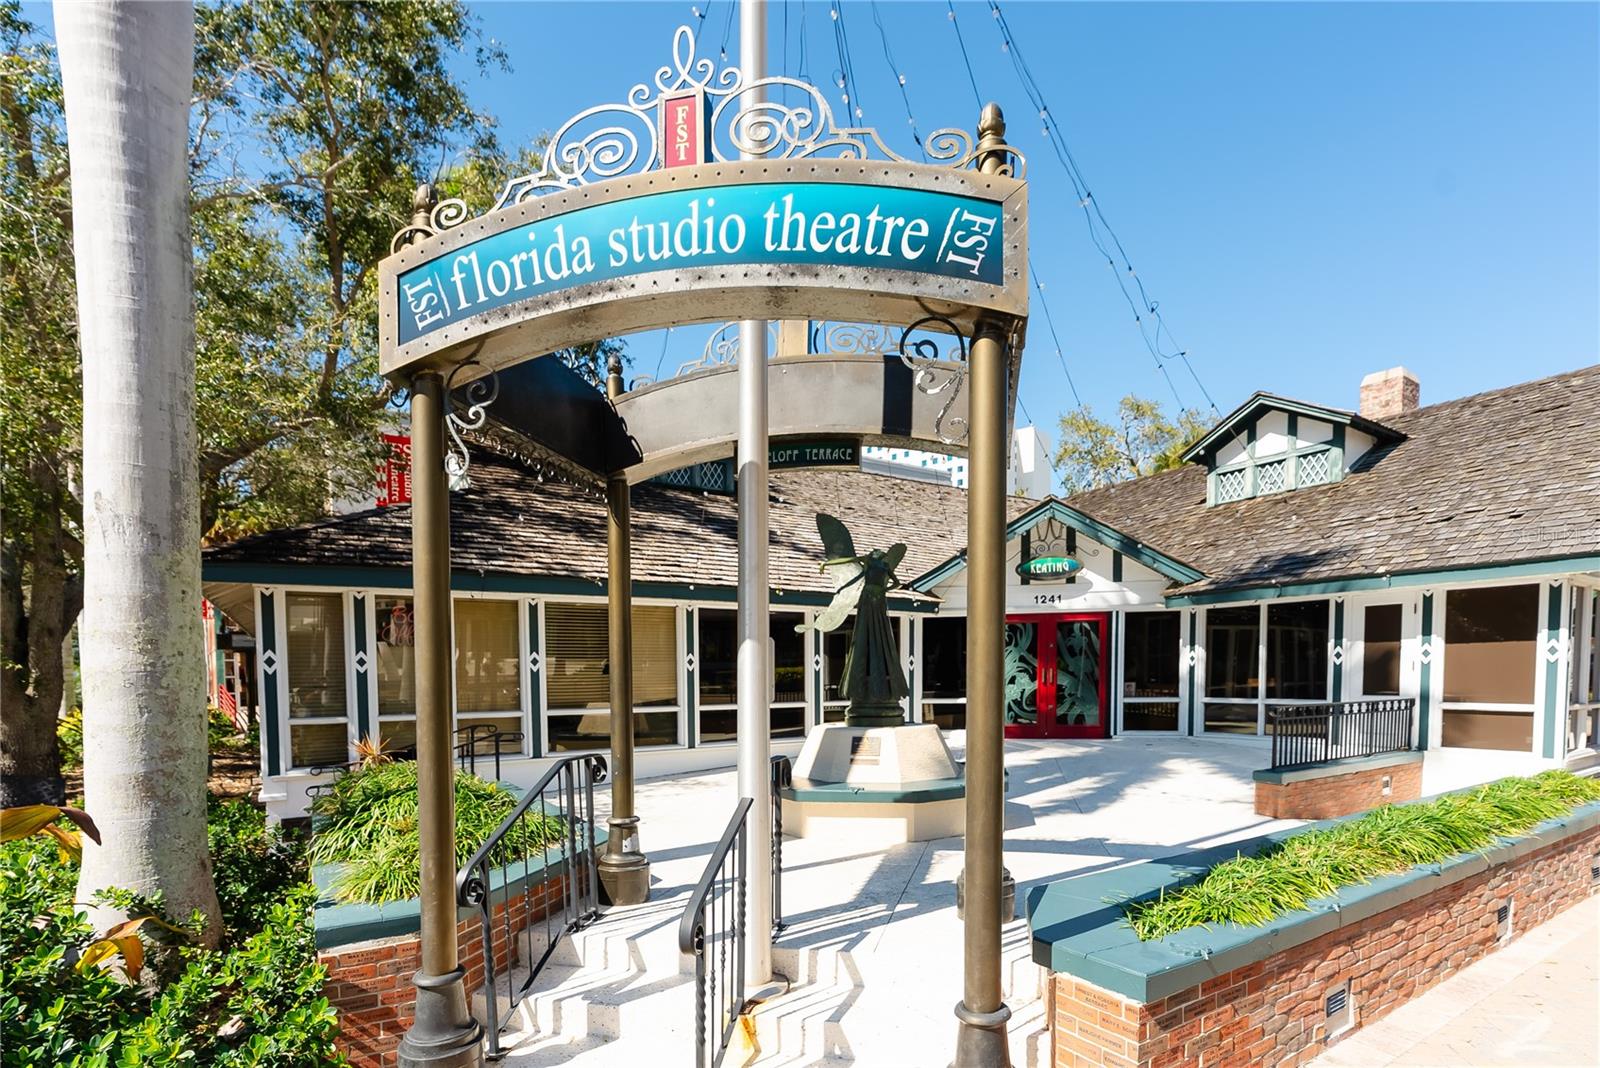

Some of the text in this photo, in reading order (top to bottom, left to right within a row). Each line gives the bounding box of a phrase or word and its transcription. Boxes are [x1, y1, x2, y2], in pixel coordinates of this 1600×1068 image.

[675, 104, 690, 161] FST
[450, 192, 930, 312] florida studio theatre
[946, 208, 997, 276] FST
[402, 276, 444, 332] FST
[805, 448, 853, 460] TERRACE
[1030, 561, 1069, 574] KEATING
[1034, 594, 1062, 604] 1241
